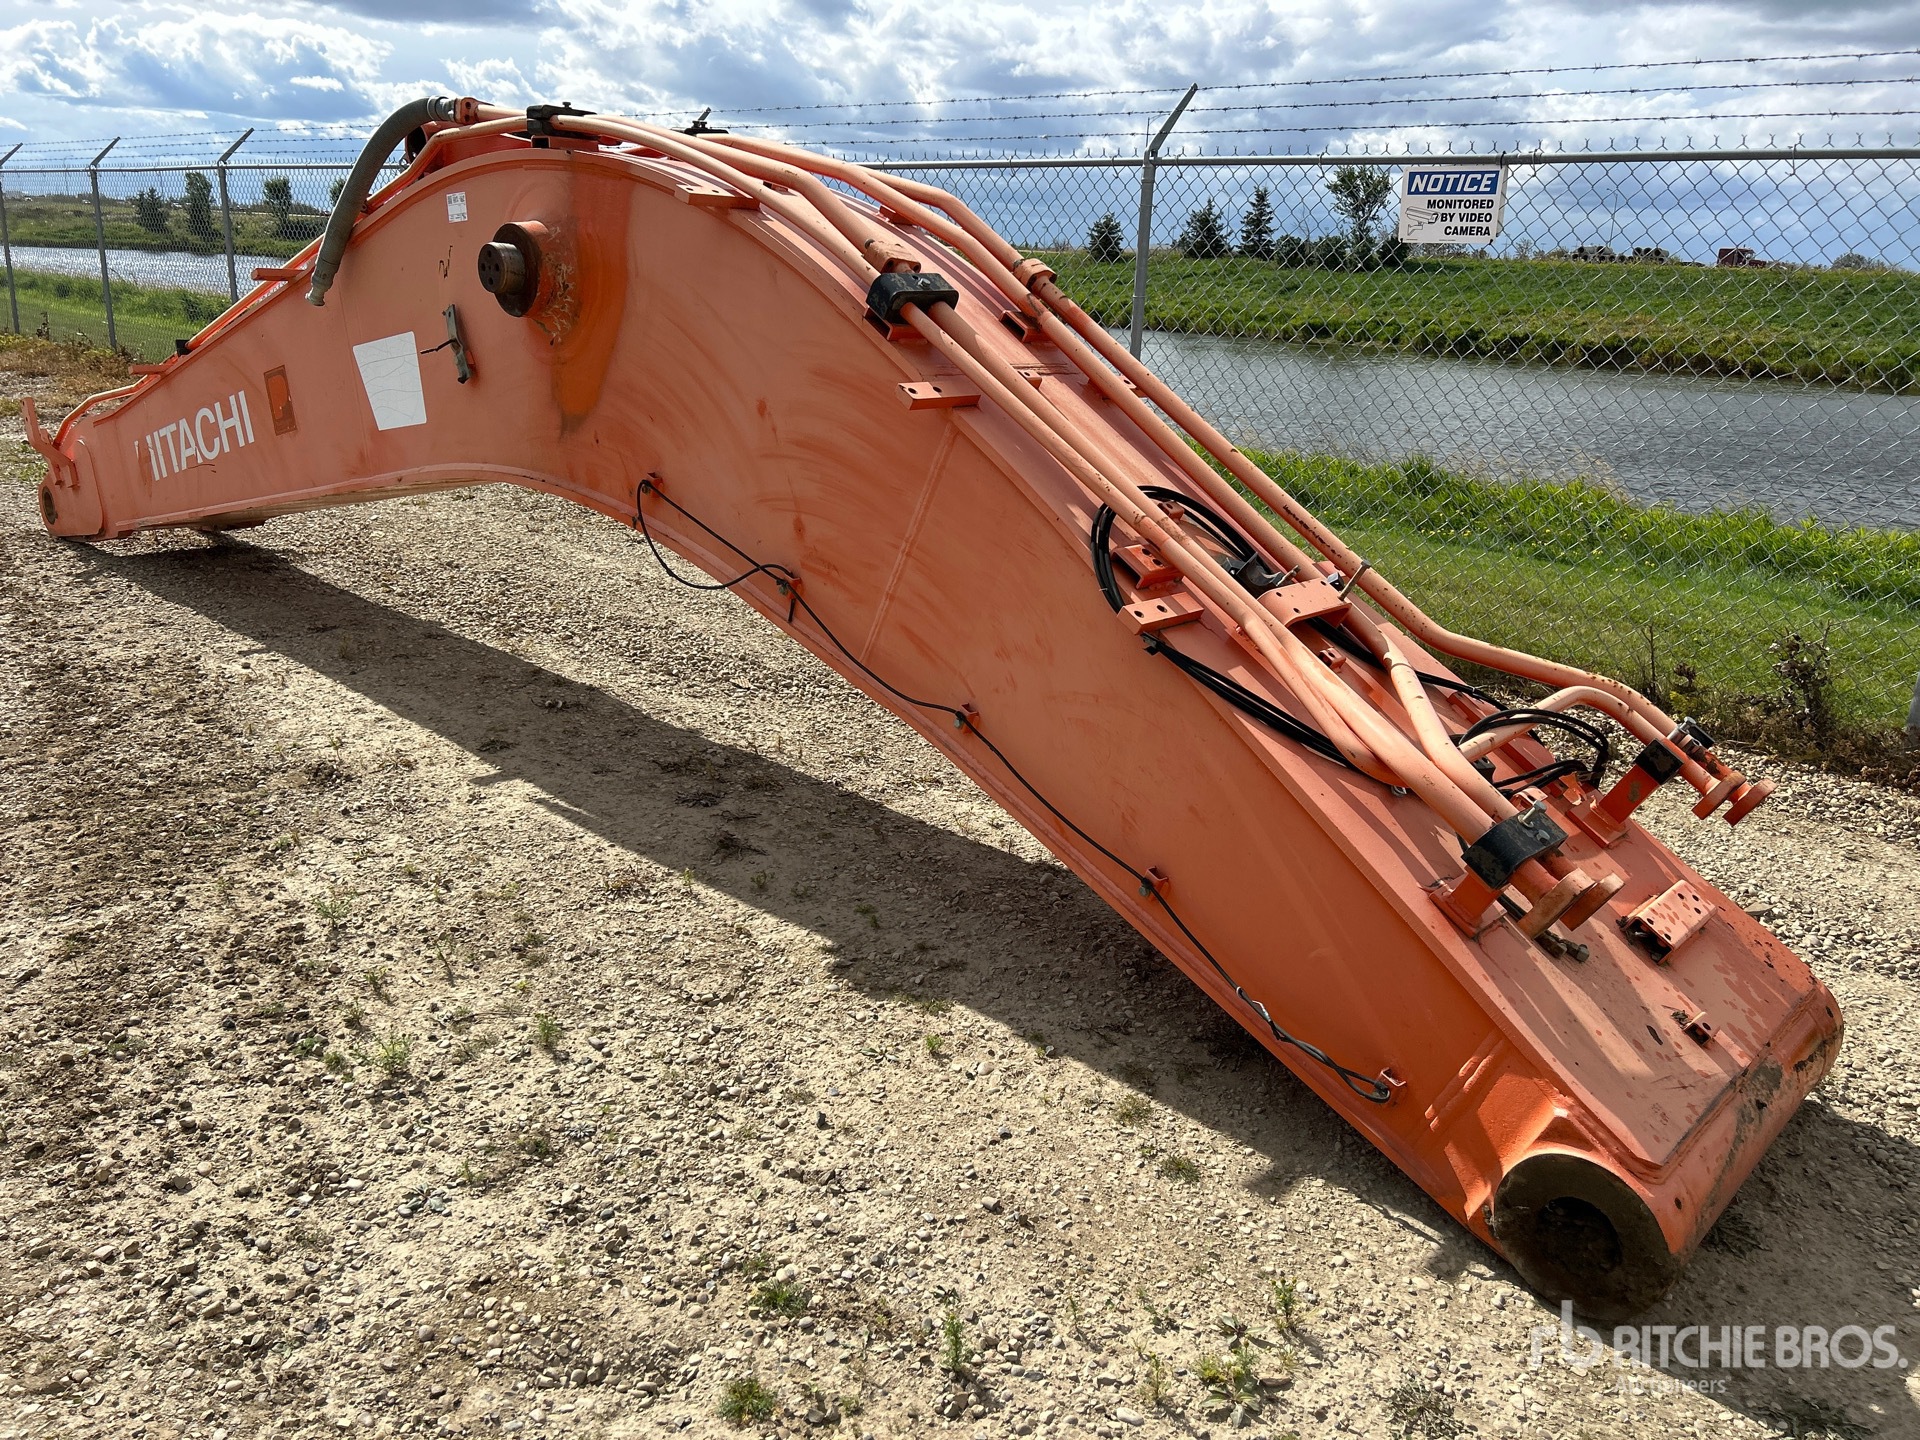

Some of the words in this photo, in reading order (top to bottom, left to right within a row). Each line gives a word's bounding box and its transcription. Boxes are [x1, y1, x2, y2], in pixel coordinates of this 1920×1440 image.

[1410, 173, 1496, 193] NOTICE
[1427, 199, 1494, 209] MONITORED
[1440, 213, 1456, 222] BY
[1459, 212, 1493, 222] VIDEO
[1444, 226, 1490, 236] CAMERA
